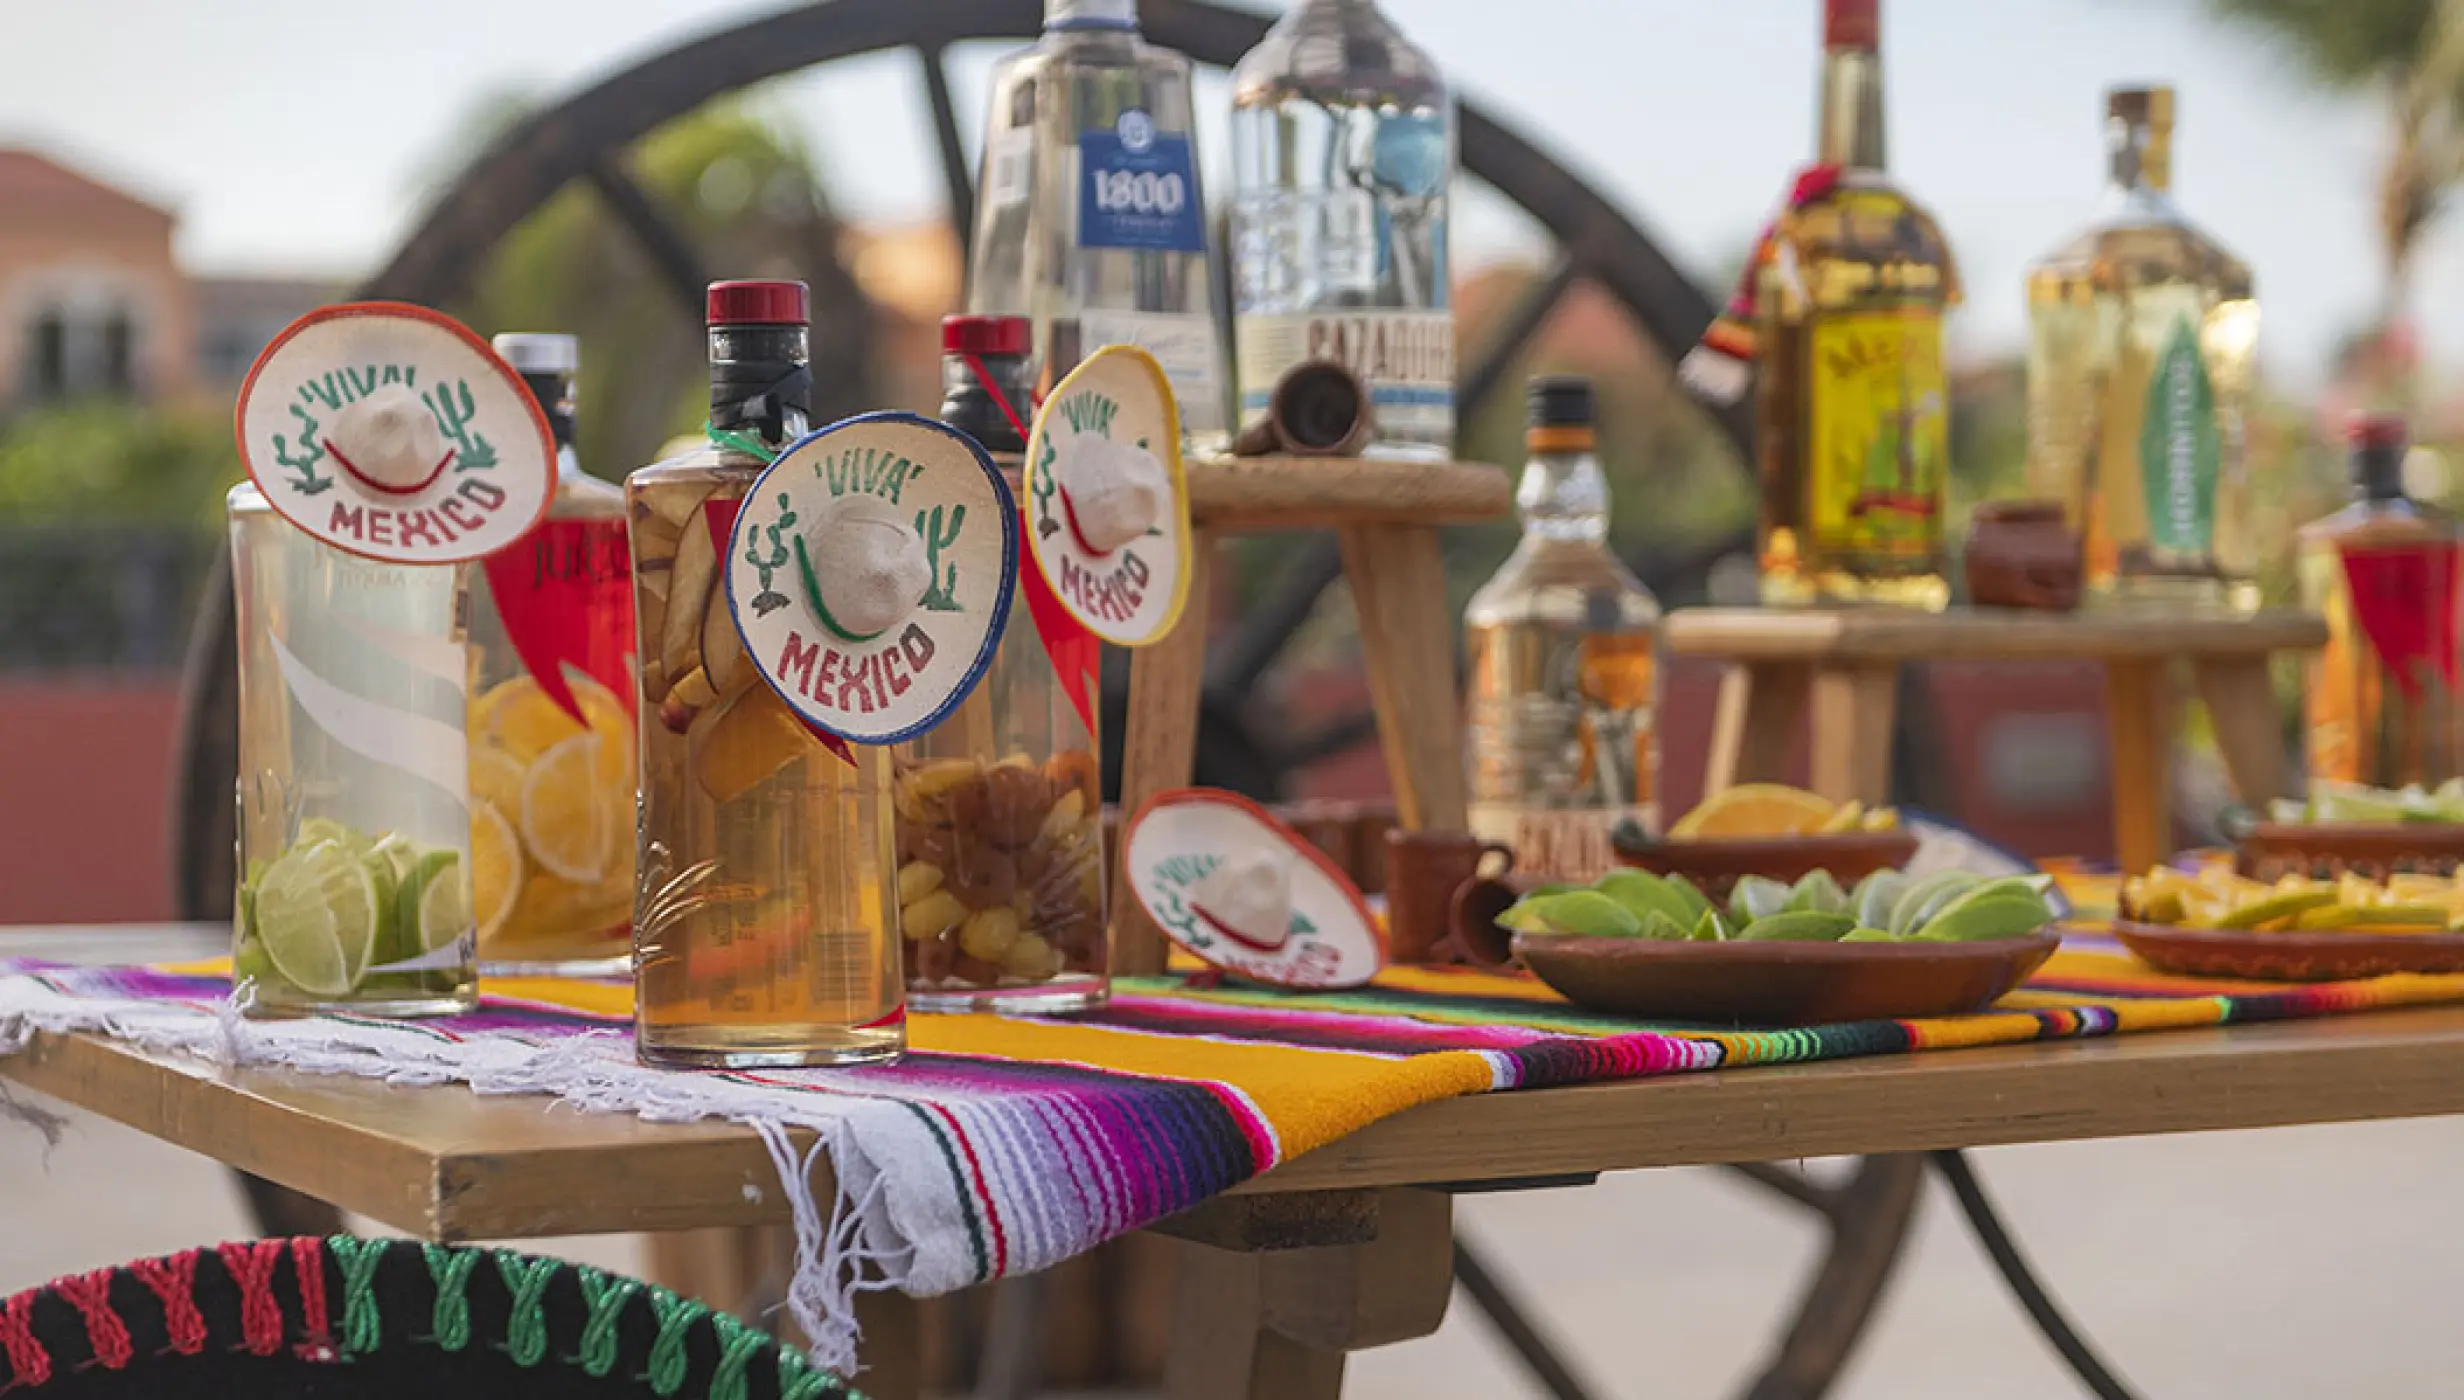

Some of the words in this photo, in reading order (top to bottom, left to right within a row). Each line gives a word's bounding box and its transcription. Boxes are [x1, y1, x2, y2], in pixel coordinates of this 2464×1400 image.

[1090, 169, 1185, 214] 1800
[329, 477, 506, 547] MEXICO
[1060, 548, 1149, 622] MEXICO
[777, 622, 935, 713] MEXICO
